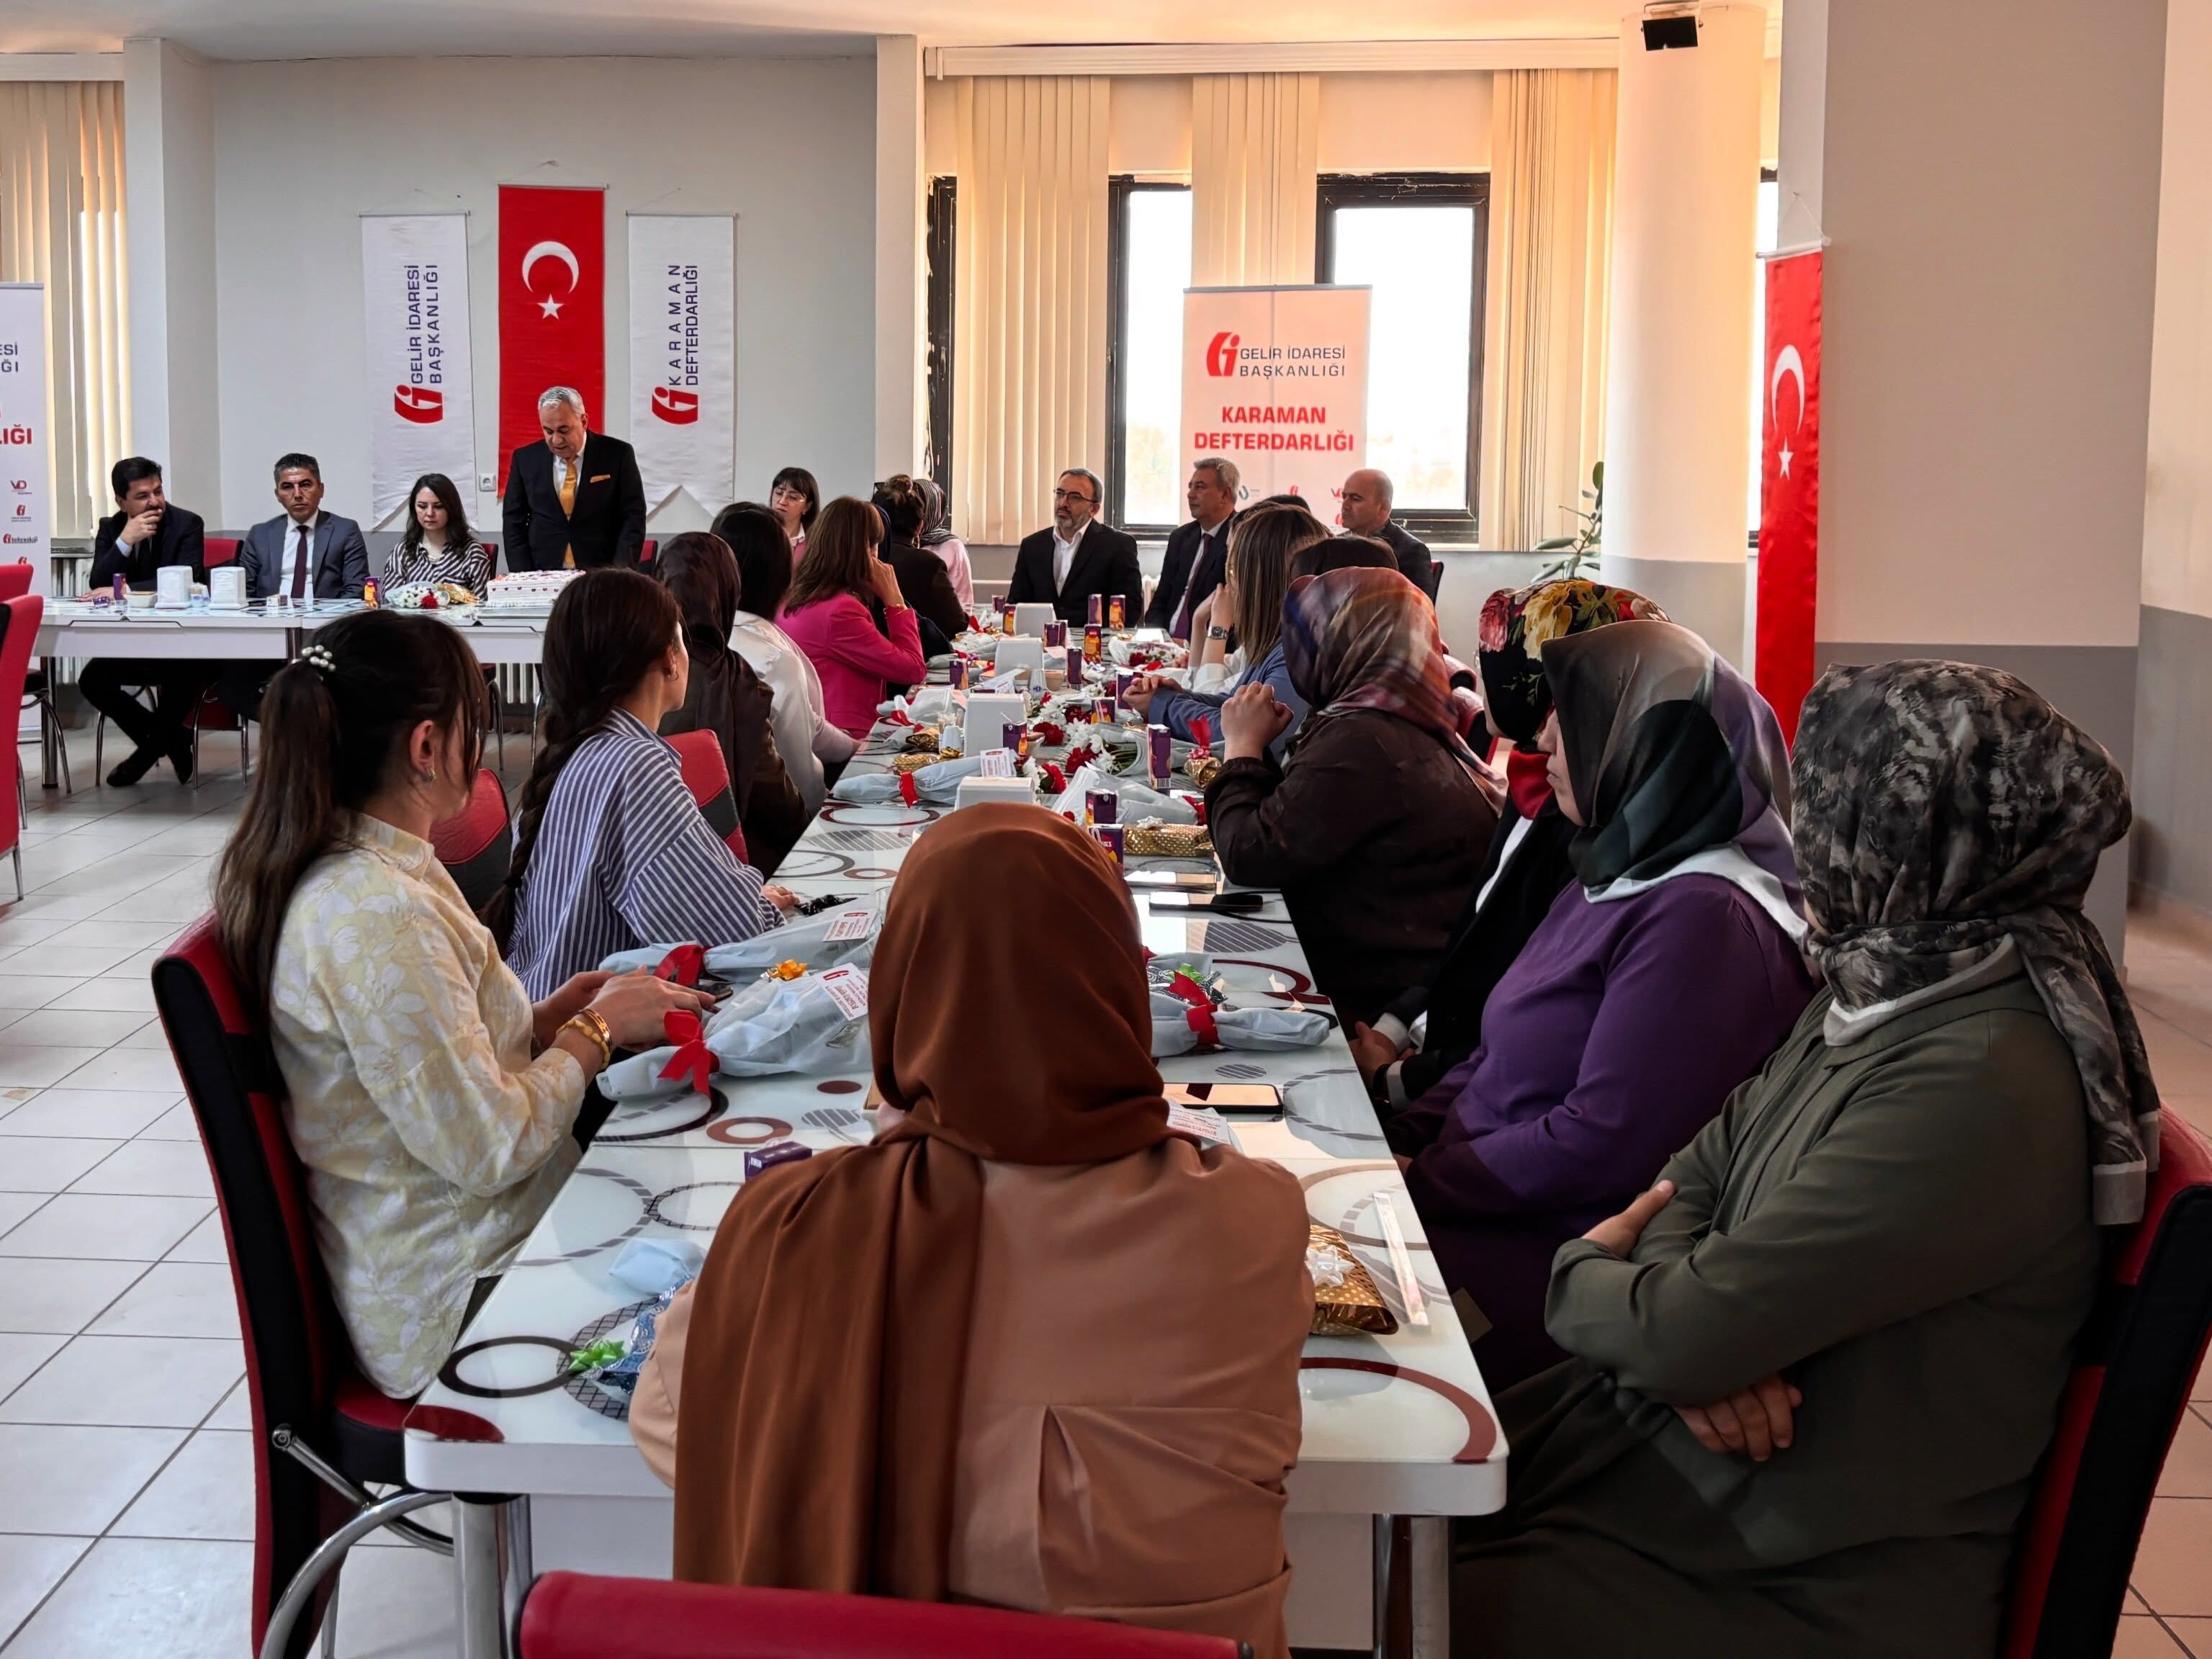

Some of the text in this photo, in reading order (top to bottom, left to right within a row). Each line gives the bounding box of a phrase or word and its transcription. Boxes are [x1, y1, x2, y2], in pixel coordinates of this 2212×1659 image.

[404, 264, 424, 385] GELİR İDARESİ
[426, 264, 444, 385] BAŞKANLIĞI
[668, 265, 681, 386] KARAMAN
[682, 265, 698, 386] DEFTERDARLIĞI
[0, 341, 18, 356] Sİ
[1240, 345, 1345, 360] GELİR İDARESİ
[1239, 362, 1345, 379] BAŞKANLIĞI
[1222, 406, 1326, 424] KARAMAN
[1194, 429, 1354, 451] DEFTERDARLIĞI
